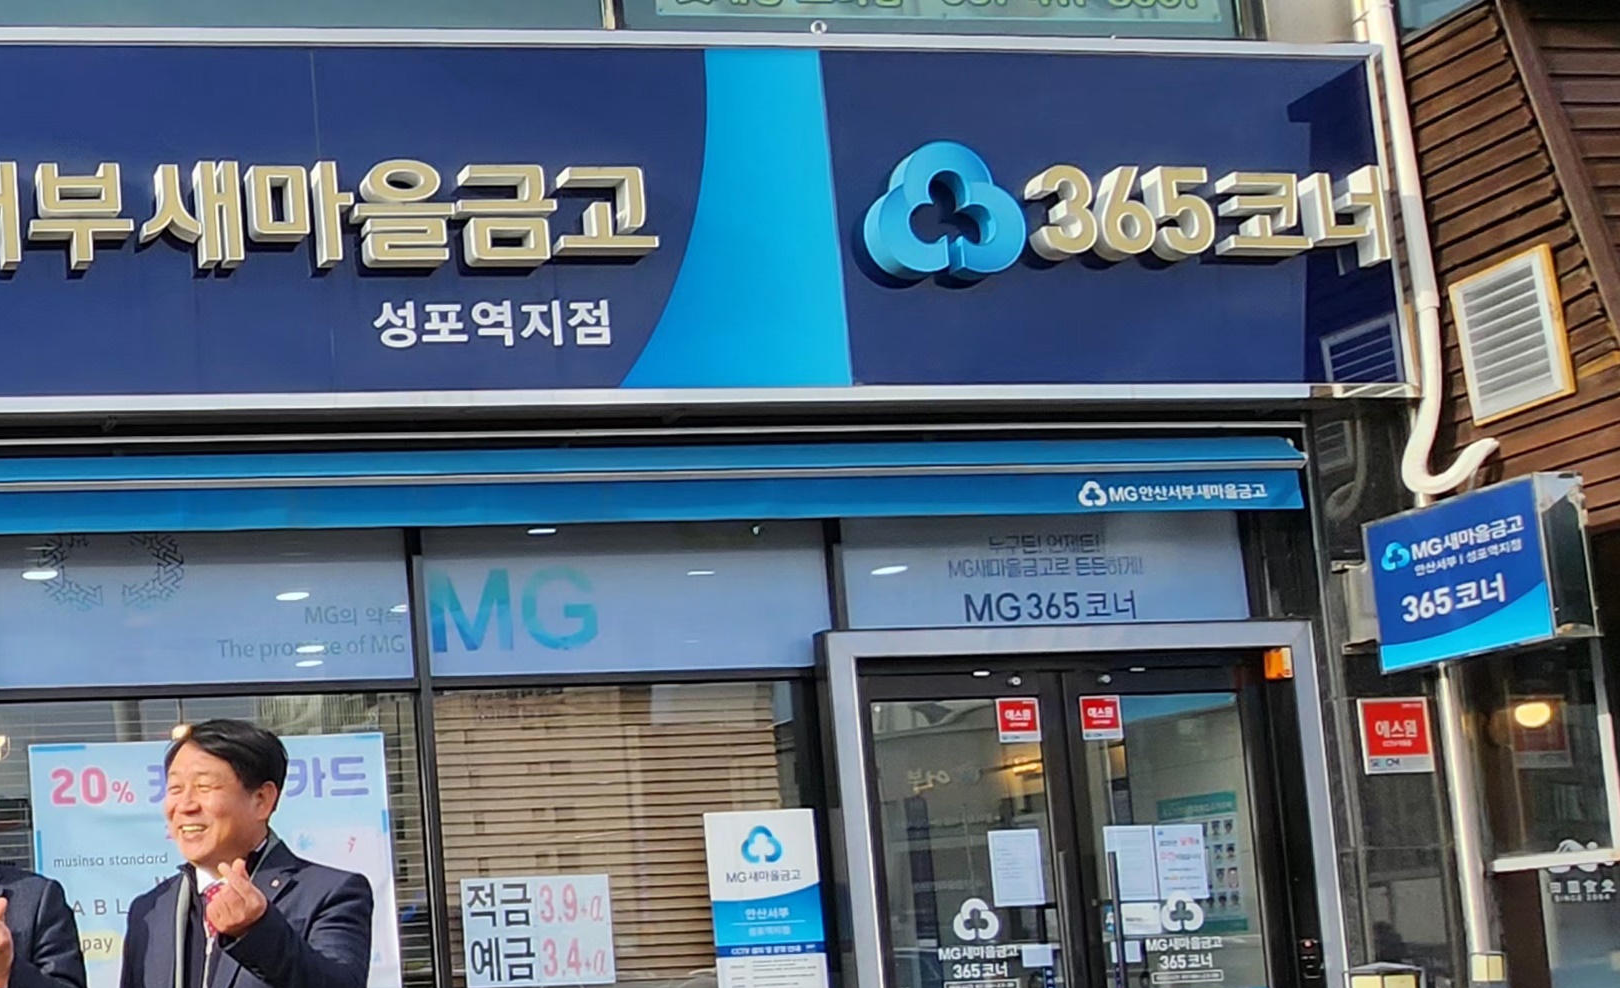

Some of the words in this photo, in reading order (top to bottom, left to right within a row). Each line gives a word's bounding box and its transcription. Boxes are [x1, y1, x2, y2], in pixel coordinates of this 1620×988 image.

[374, 300, 612, 349] 성포역지점
[304, 606, 358, 626] MG의
[426, 566, 599, 652] MG
[217, 638, 254, 658] The
[346, 634, 368, 654] of
[1374, 719, 1418, 738] 에스원
[50, 766, 135, 806] 20%
[53, 856, 105, 868] musinsa
[109, 853, 168, 866] standard
[467, 882, 532, 928] 적금
[744, 907, 790, 921] 안산서부
[470, 936, 536, 982] 예금
